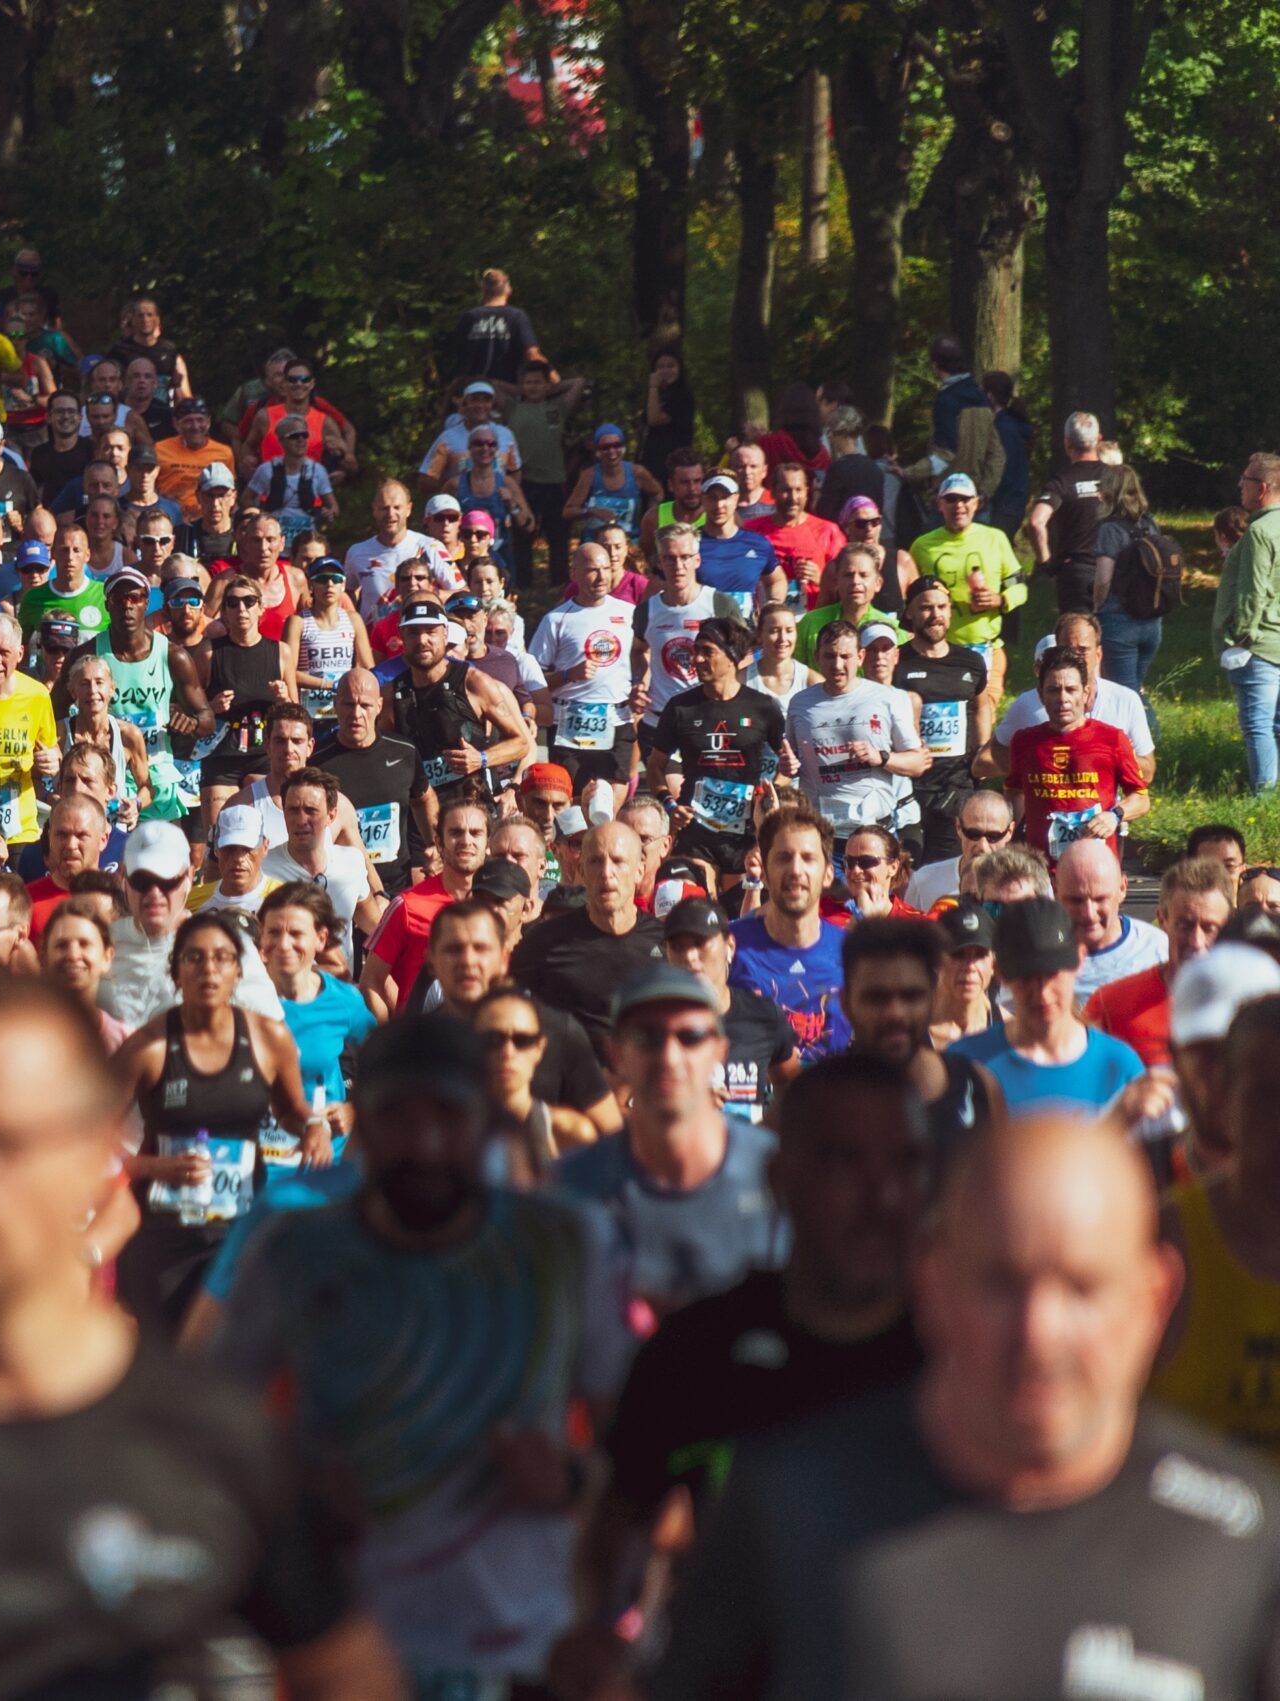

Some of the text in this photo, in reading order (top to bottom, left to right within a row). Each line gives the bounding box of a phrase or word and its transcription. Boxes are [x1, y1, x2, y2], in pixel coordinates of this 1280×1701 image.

[308, 647, 352, 660] PERU
[568, 717, 608, 732] 15433
[919, 720, 960, 737] 28435
[816, 743, 852, 757] FINIS
[818, 762, 872, 776] IRONMAN
[820, 774, 842, 785] 70.3
[1033, 787, 1100, 799] VALENCIA
[702, 794, 746, 818] 53738
[358, 823, 392, 843] 167
[727, 1061, 759, 1084] 26.2
